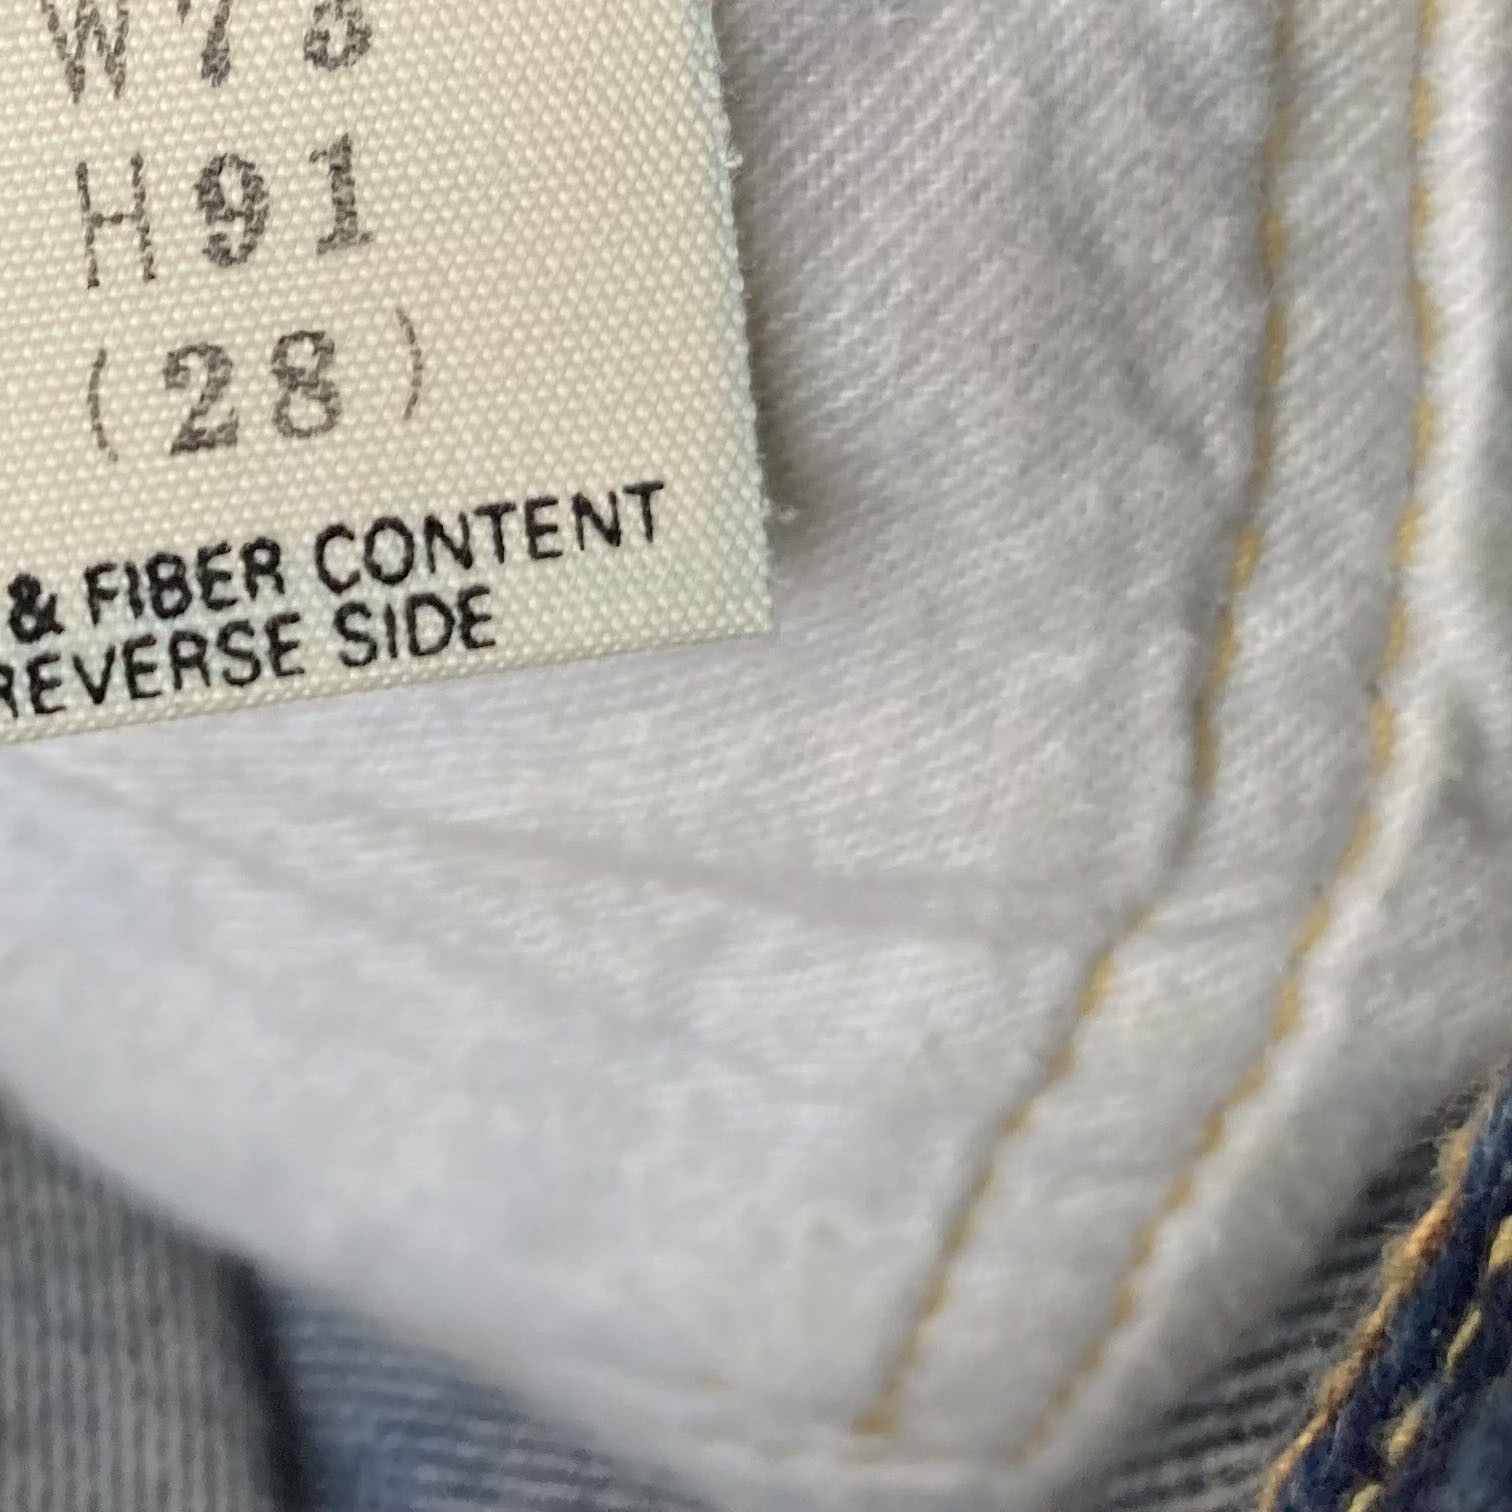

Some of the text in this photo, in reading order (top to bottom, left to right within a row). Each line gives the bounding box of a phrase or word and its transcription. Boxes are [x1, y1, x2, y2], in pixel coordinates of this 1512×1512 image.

[74, 132, 373, 291] H91
[86, 308, 425, 463] (28)
[5, 571, 67, 646] &
[83, 534, 287, 629] FIBER
[312, 478, 667, 595] CONTENT
[332, 582, 497, 670] SIDE
